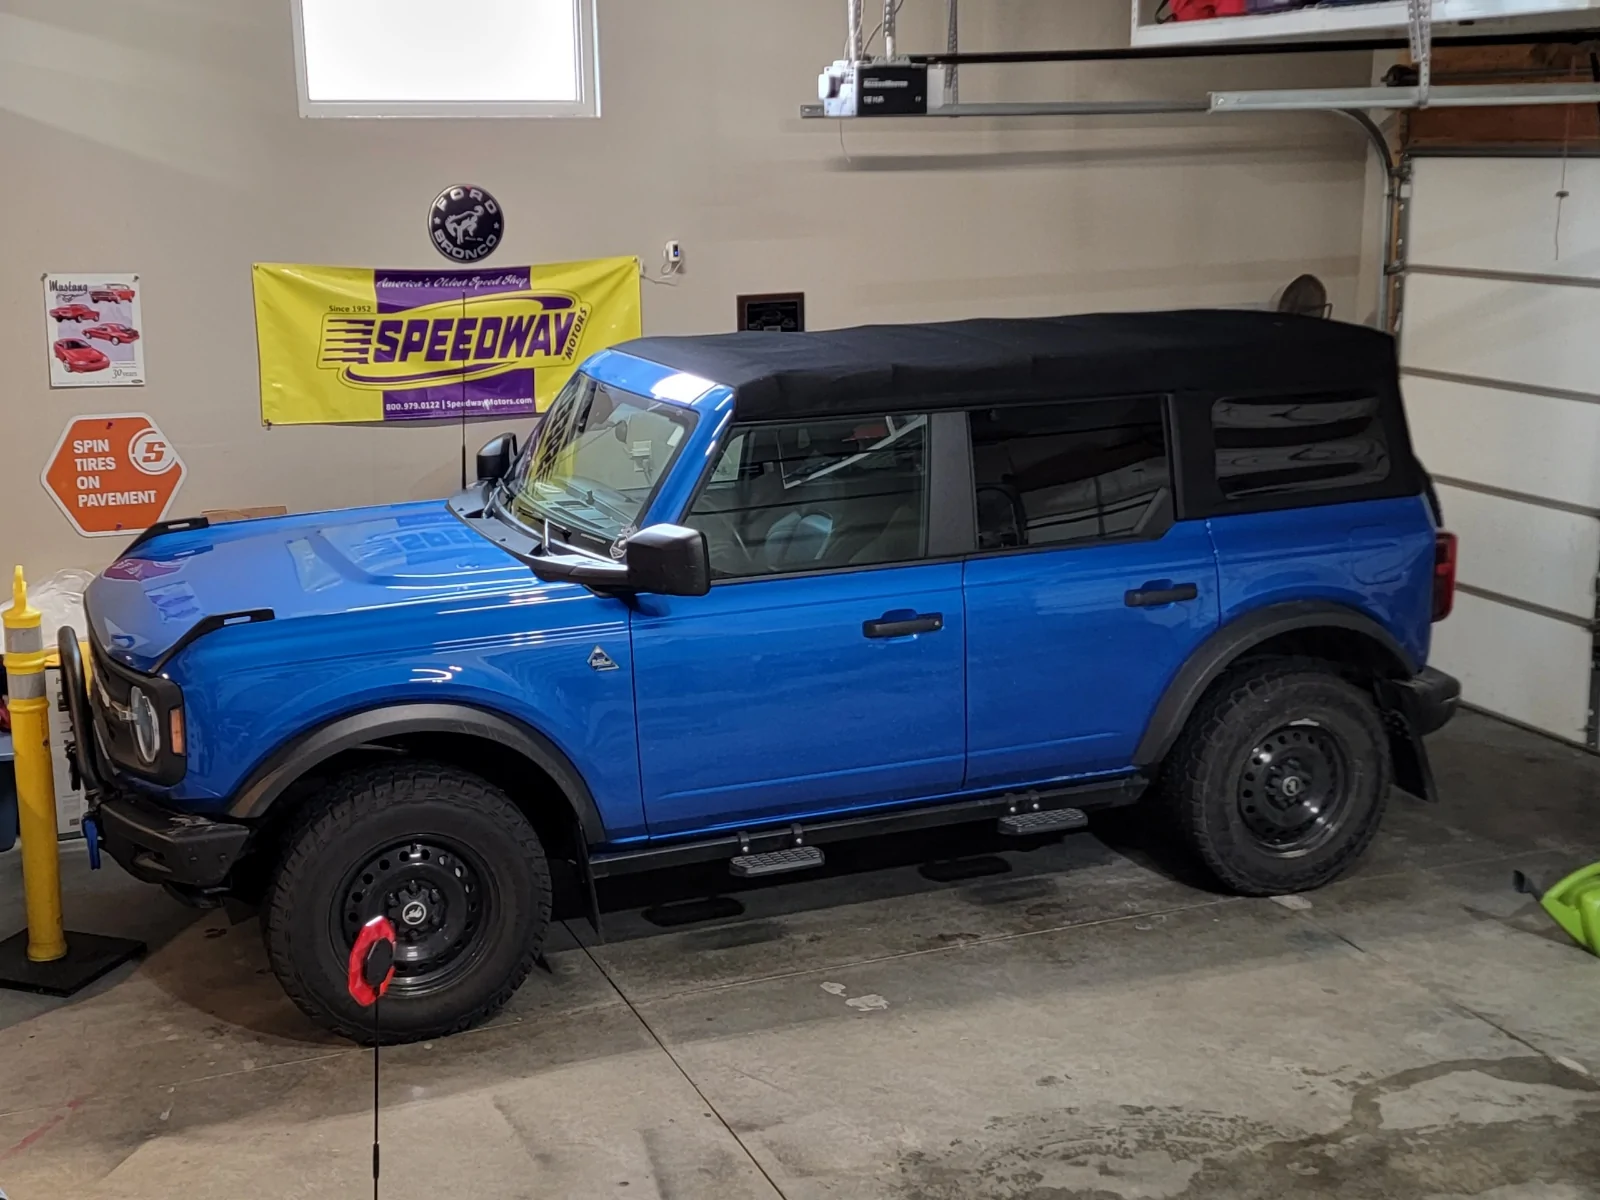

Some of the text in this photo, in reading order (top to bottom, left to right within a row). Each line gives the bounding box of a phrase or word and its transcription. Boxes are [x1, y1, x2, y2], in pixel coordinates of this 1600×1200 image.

[436, 188, 497, 214] FORD
[434, 229, 497, 260] BRONCO
[49, 280, 88, 293] Mustang
[376, 275, 527, 290] America's Oldest Speed Shop
[328, 304, 371, 312] Since 1952
[373, 311, 576, 363] SPEEDWAY
[565, 306, 587, 360] MOTORS
[111, 368, 122, 379] 30
[385, 401, 440, 410] 800.979.0122
[73, 439, 110, 454] SPIN
[74, 456, 117, 472] TIRES
[76, 475, 100, 490] ON
[78, 490, 157, 507] PAVEMENT
